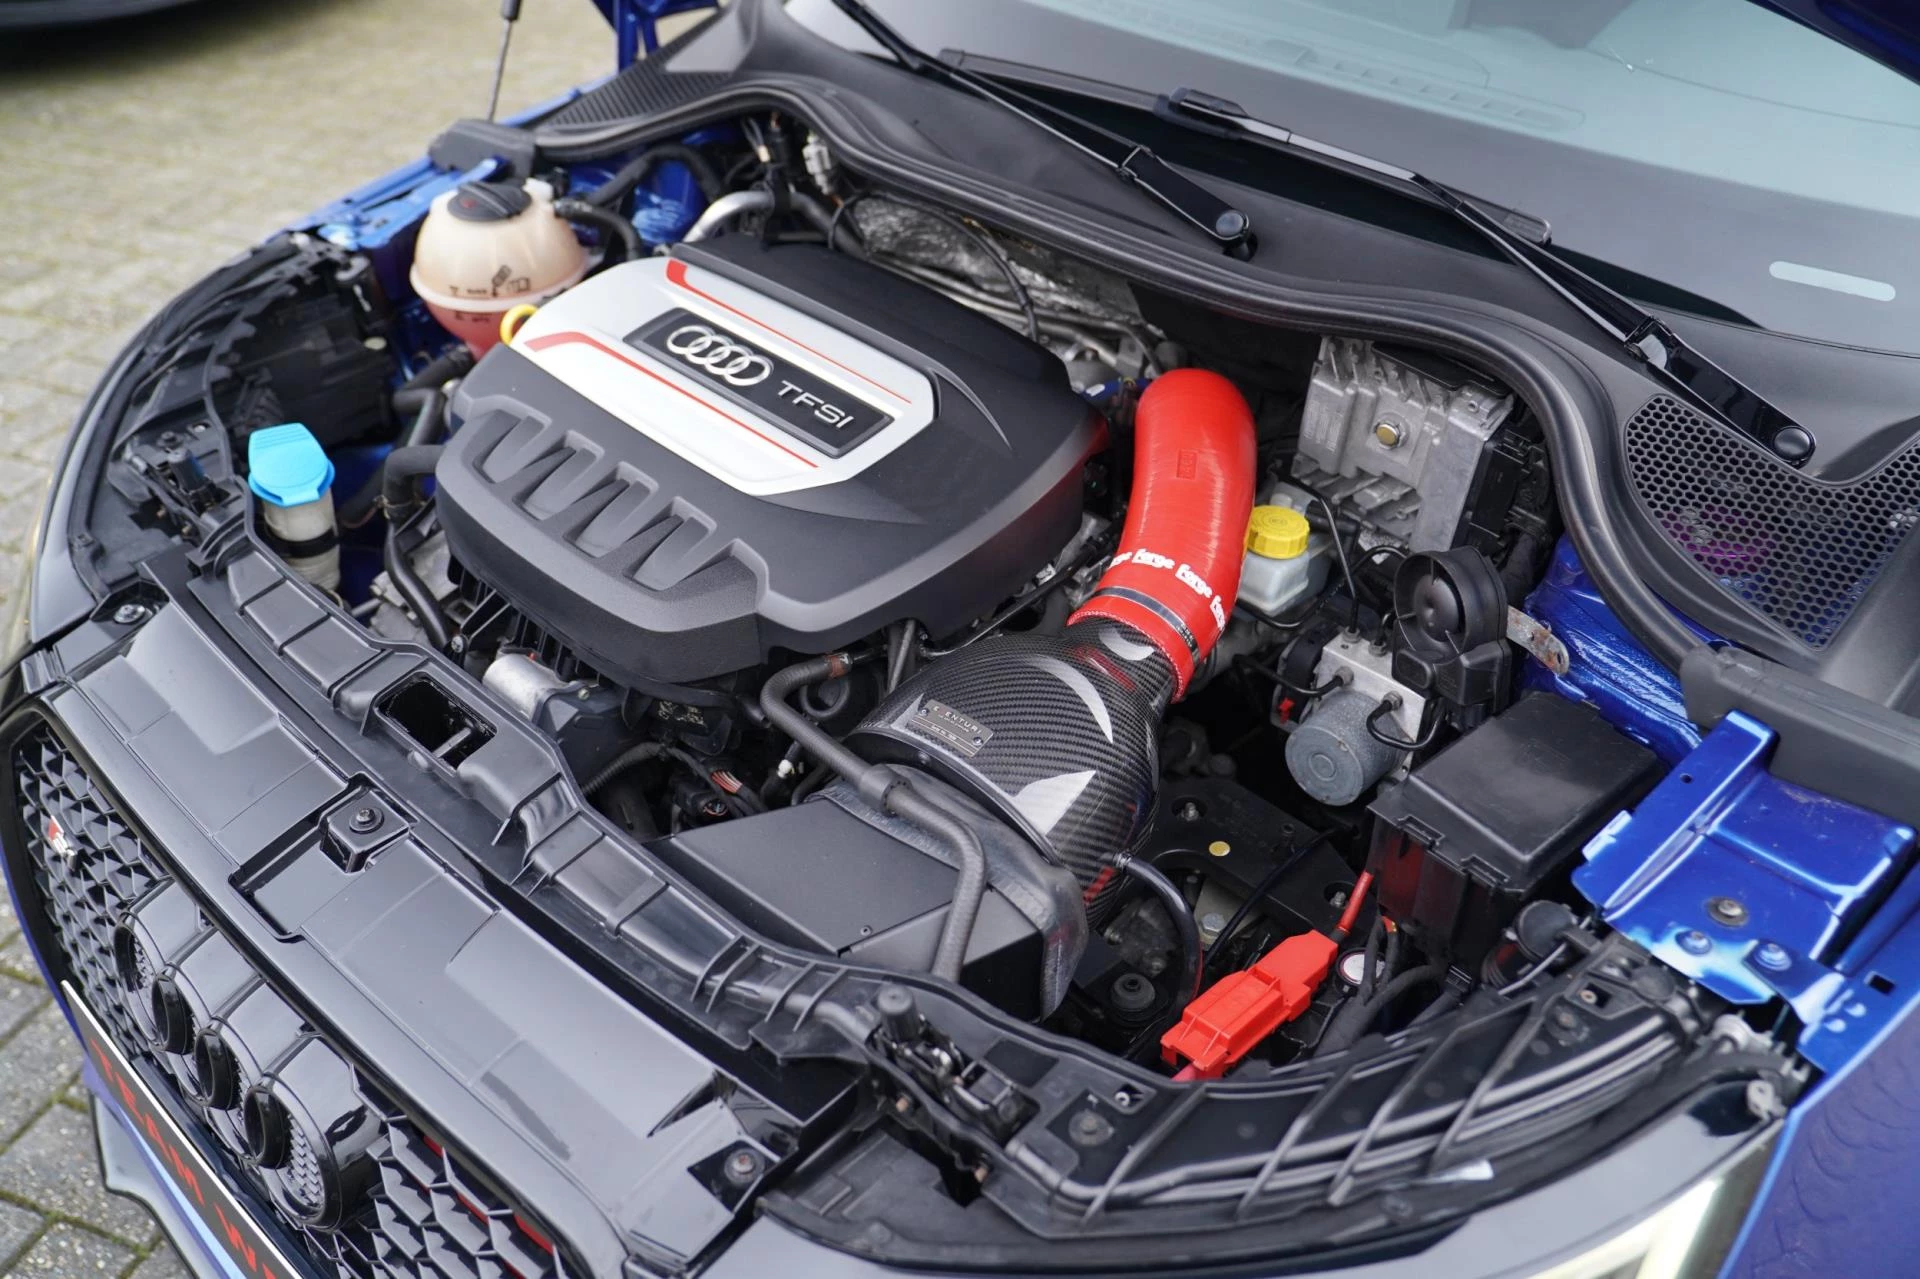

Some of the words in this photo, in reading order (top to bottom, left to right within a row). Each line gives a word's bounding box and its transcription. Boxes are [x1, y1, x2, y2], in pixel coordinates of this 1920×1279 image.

[778, 380, 854, 428] TFSI
[1132, 548, 1175, 569] Forge
[1175, 563, 1212, 598] Forge
[933, 706, 982, 734] EENTURI
[92, 1039, 205, 1208] TEAM
